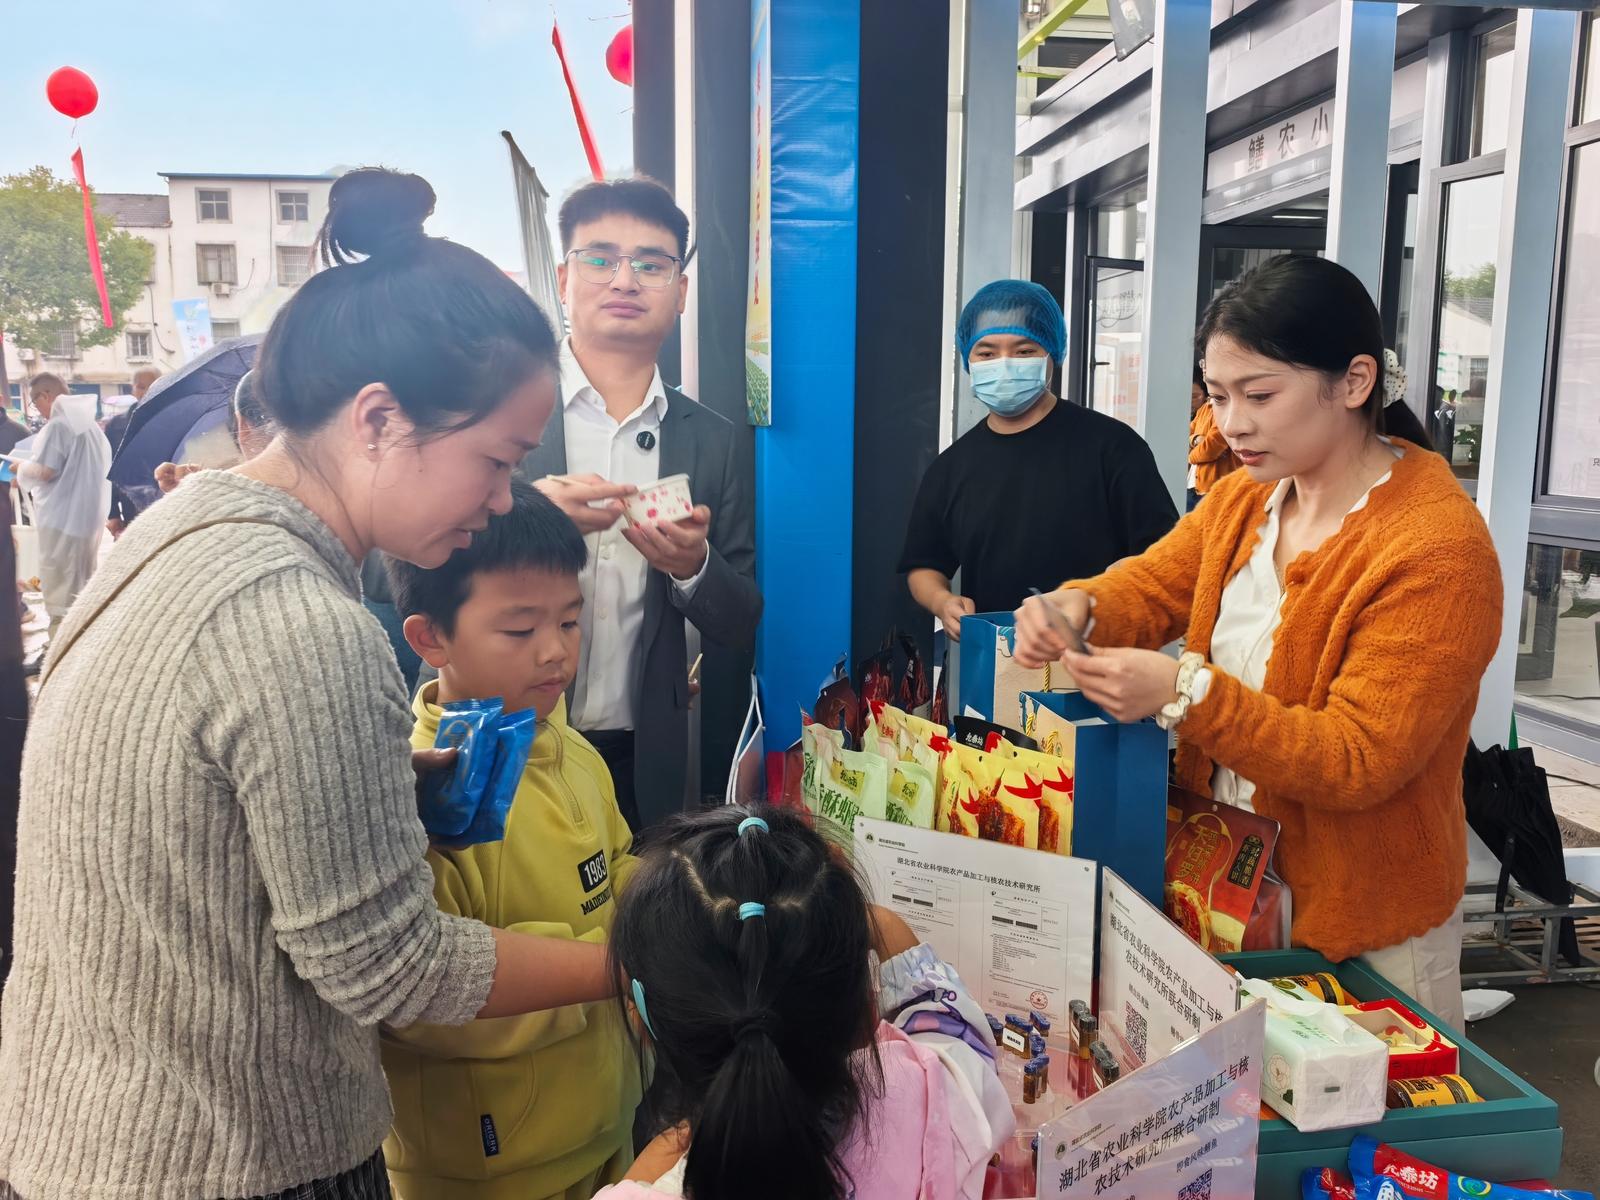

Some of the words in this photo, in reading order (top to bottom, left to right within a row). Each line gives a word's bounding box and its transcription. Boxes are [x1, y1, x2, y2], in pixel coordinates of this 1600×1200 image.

[584, 854, 607, 886] 1983
[896, 856, 1041, 894] 湖北省农业科学院农产品加工与核农技术研究所
[1125, 948, 1202, 1033] 农技术研究所联合研制
[1058, 1055, 1250, 1192] 湖北省农业科学院农产品加工与核
[1094, 1096, 1221, 1196] 农技术研究所联合研制
